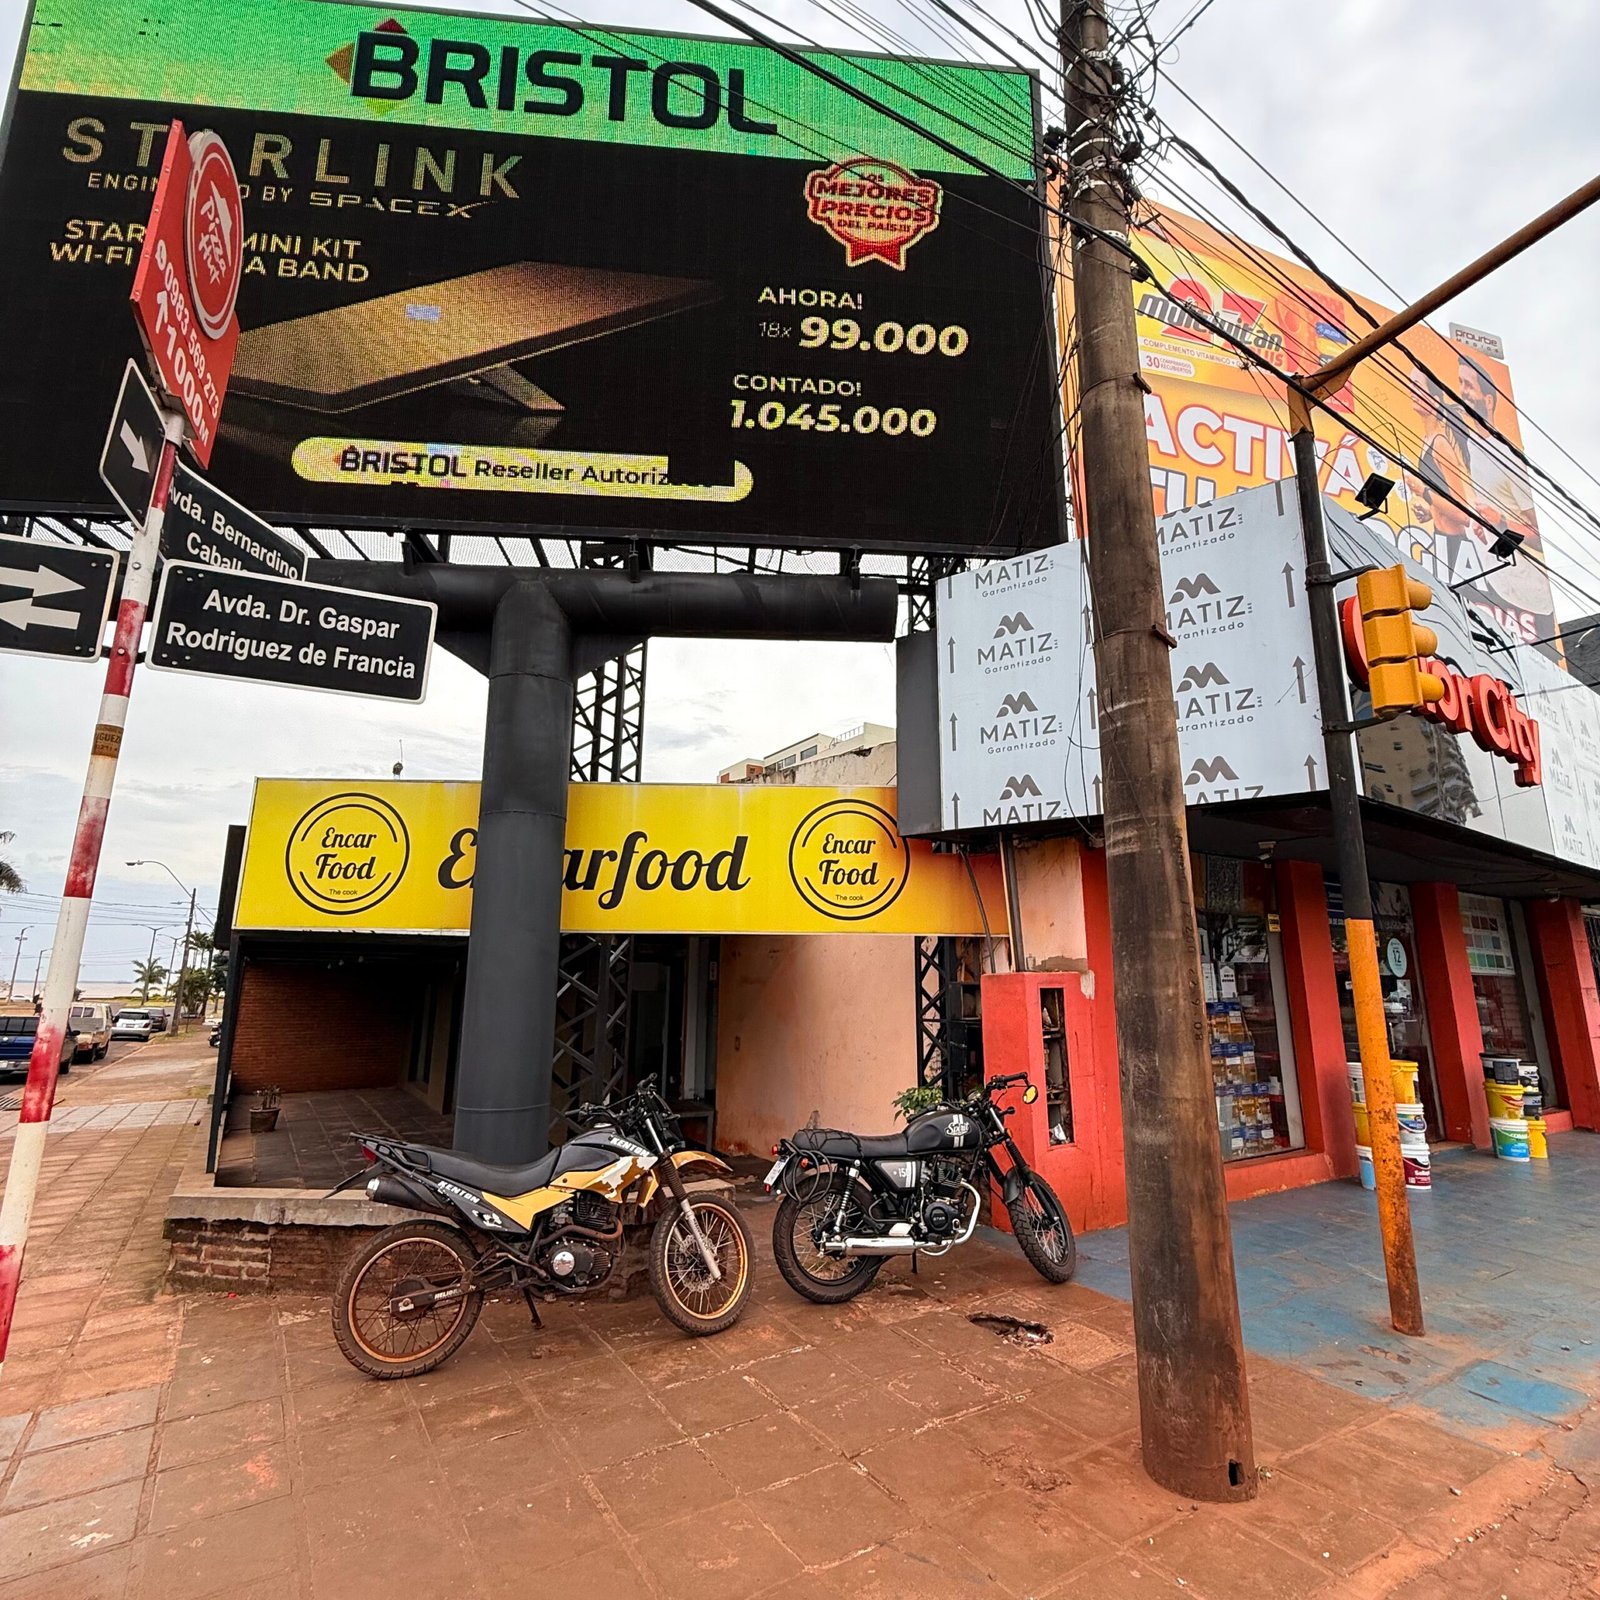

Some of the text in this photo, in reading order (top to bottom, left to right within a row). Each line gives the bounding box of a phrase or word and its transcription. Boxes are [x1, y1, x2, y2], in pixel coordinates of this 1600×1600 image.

[351, 31, 777, 135] BRISTOL
[62, 117, 522, 198] STRLINK
[262, 186, 293, 203] BY
[310, 191, 498, 219] SPACEX
[817, 181, 929, 203] MEJORES
[820, 200, 927, 221] PRECIOS
[838, 219, 861, 229] DEL
[200, 196, 226, 279] Pizza
[312, 236, 361, 260] KIT
[50, 242, 133, 266] WI-FI
[278, 258, 369, 283] BAND
[199, 233, 221, 285] Hut
[758, 287, 863, 310] AHORA!
[165, 263, 219, 419] 0983 569 273
[758, 316, 969, 357] 18x 99.000
[1143, 338, 1196, 355] COMPLEMENTO
[1456, 330, 1497, 347] prourbe
[1146, 355, 1160, 369] 30
[1160, 364, 1192, 375] RECUBIERTOS
[733, 374, 862, 397] CONTADO!
[730, 400, 937, 437] 1.045.000
[340, 449, 467, 477] BRISTOL
[475, 460, 573, 481] Reseller
[211, 511, 298, 581] Bernardino
[1162, 532, 1235, 556] arantizado
[975, 554, 1049, 589] MATIZ
[982, 575, 1047, 598] Garantizado
[203, 589, 400, 640] Avda. Dr. Gaspar
[166, 622, 416, 680] Rodriguez de Francia
[977, 633, 1053, 665] MATIZ
[984, 655, 1051, 675] Garantizado
[1174, 688, 1255, 720] ATIZ
[980, 715, 1057, 745] MATIZ
[1177, 715, 1254, 733] arantizado
[987, 737, 1055, 754] Garantizado
[983, 801, 1062, 827] MATIZ
[321, 827, 377, 849] Encar
[821, 833, 876, 855] Encar
[315, 852, 376, 880] Food
[819, 859, 879, 886] Food
[329, 888, 358, 896] The cook
[610, 1137, 650, 1157] KENTON
[437, 1181, 481, 1204] KENTON
